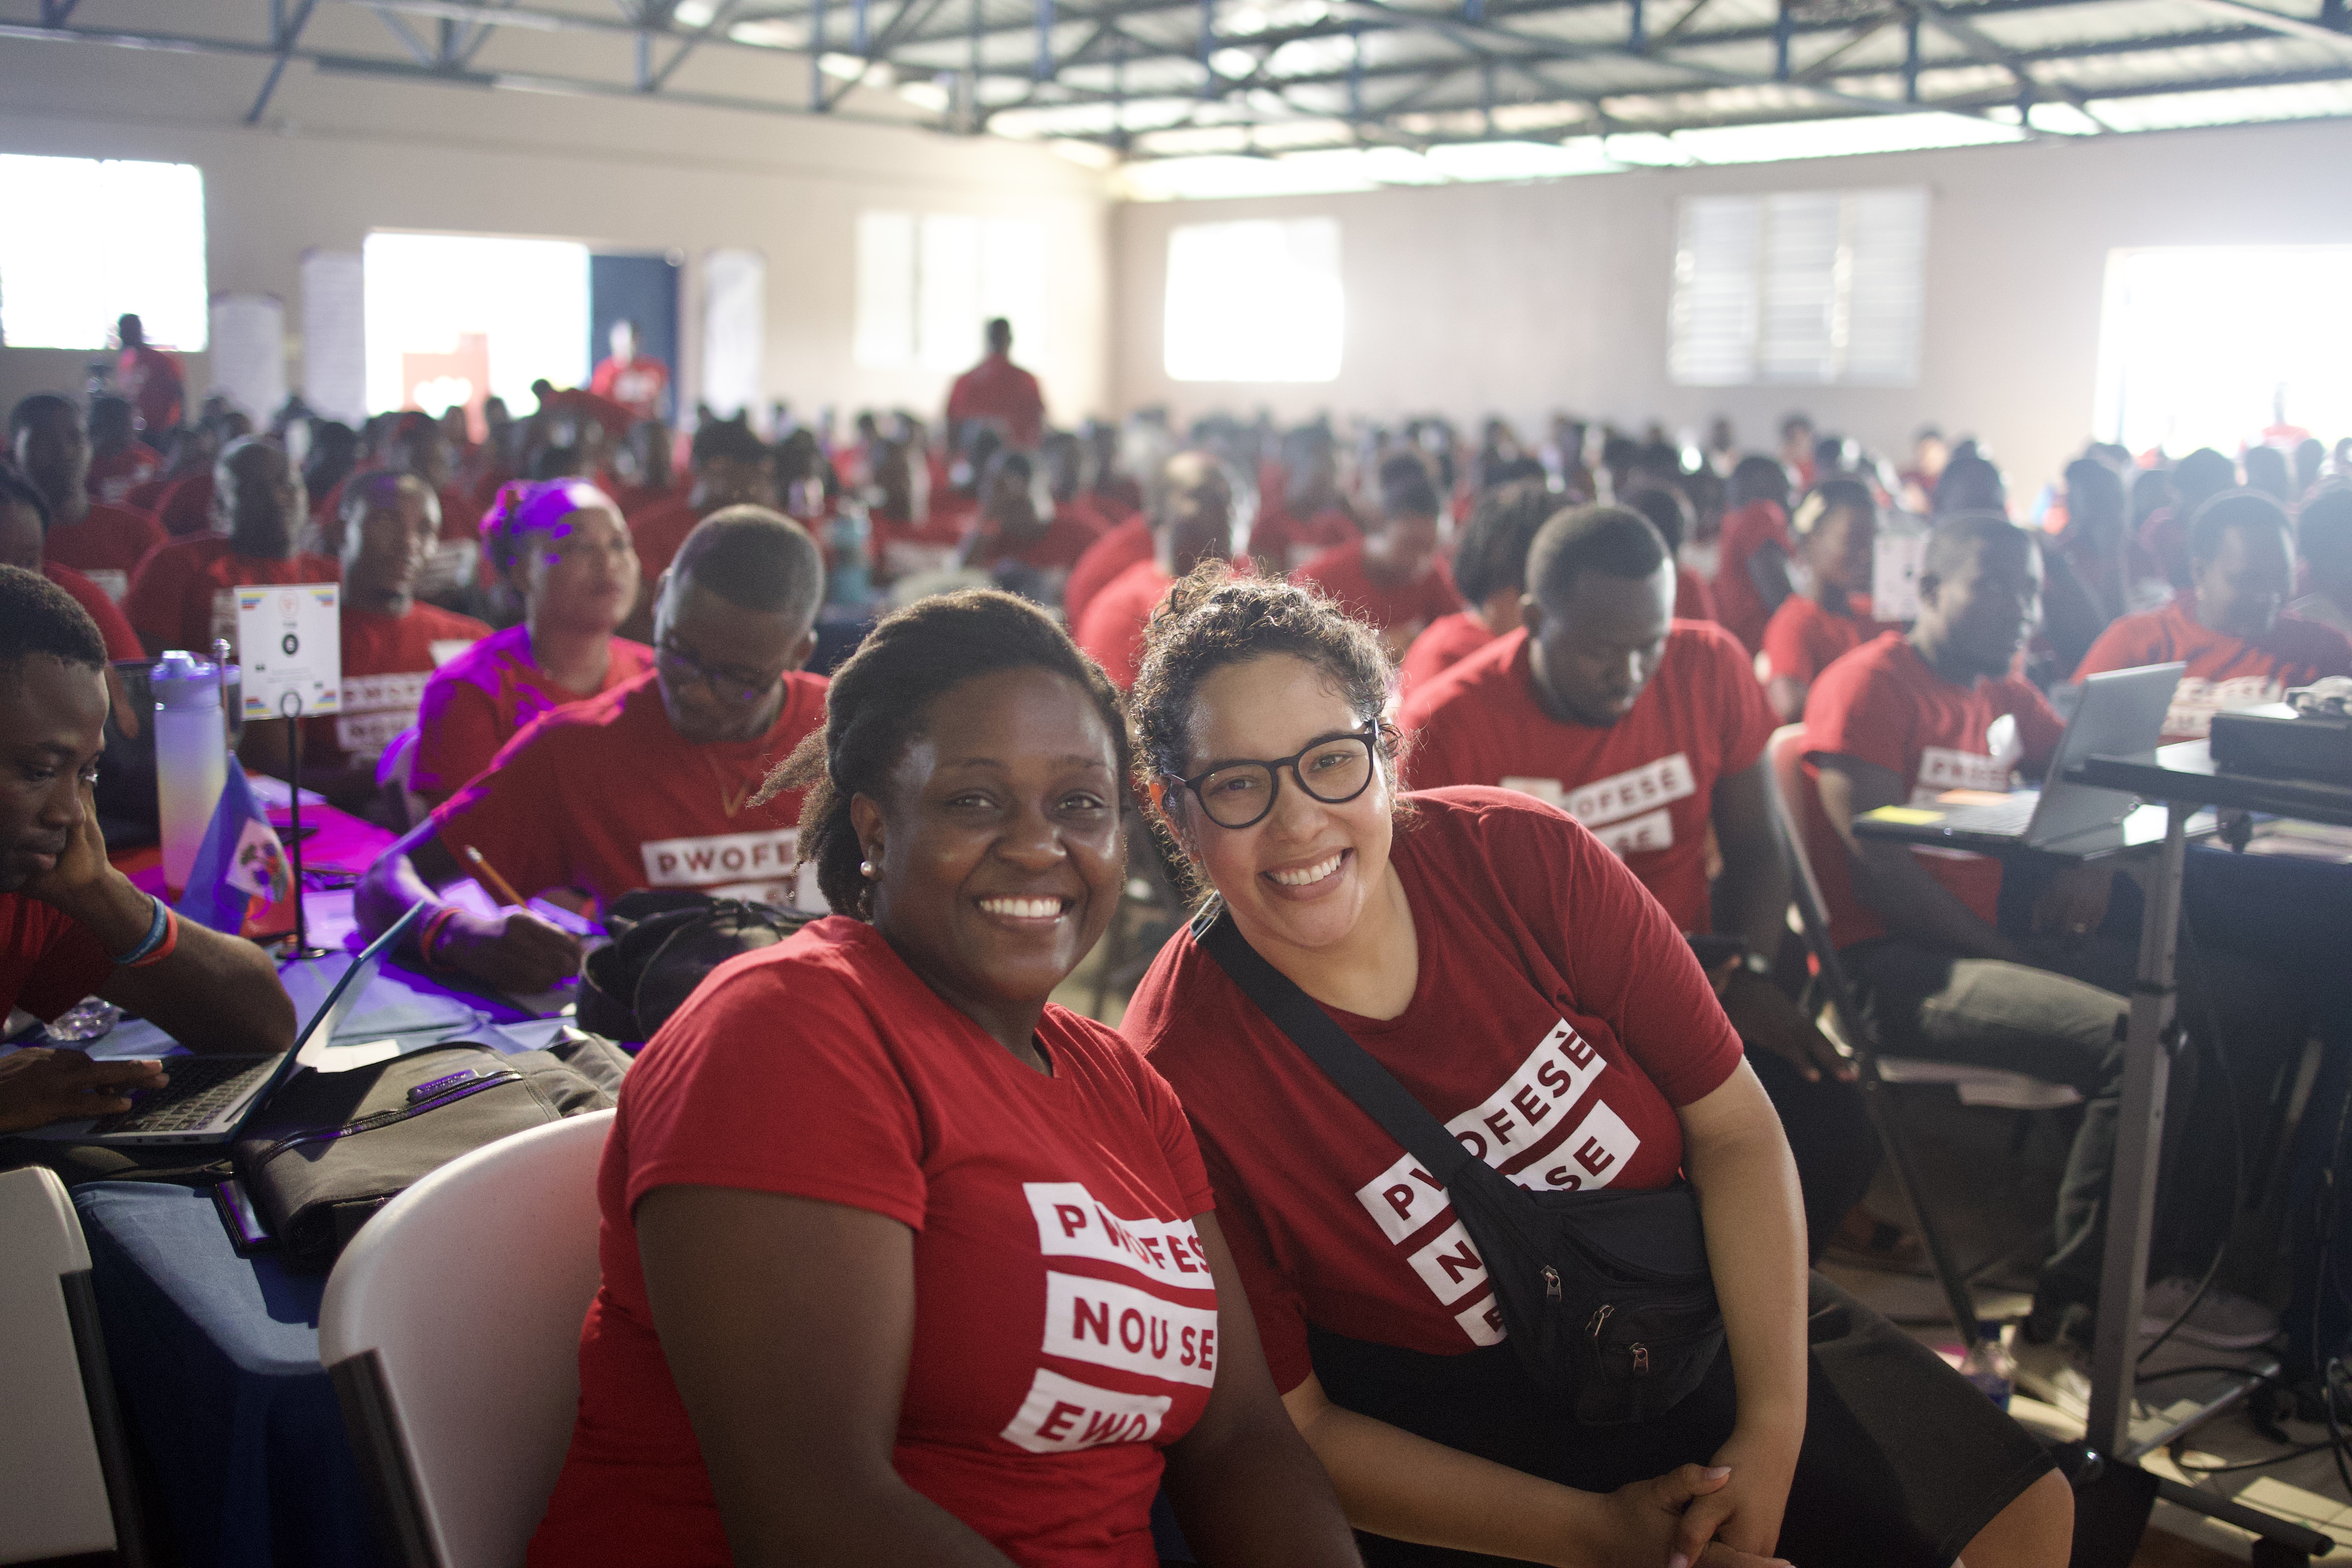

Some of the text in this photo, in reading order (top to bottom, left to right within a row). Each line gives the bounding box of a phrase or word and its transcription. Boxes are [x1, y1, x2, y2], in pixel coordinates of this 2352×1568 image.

[1382, 1030, 1596, 1221] POFESÈ
[1545, 1136, 1615, 1191] SE
[1072, 1296, 1214, 1371] NOU SE
[1035, 1400, 1148, 1443] EWO
